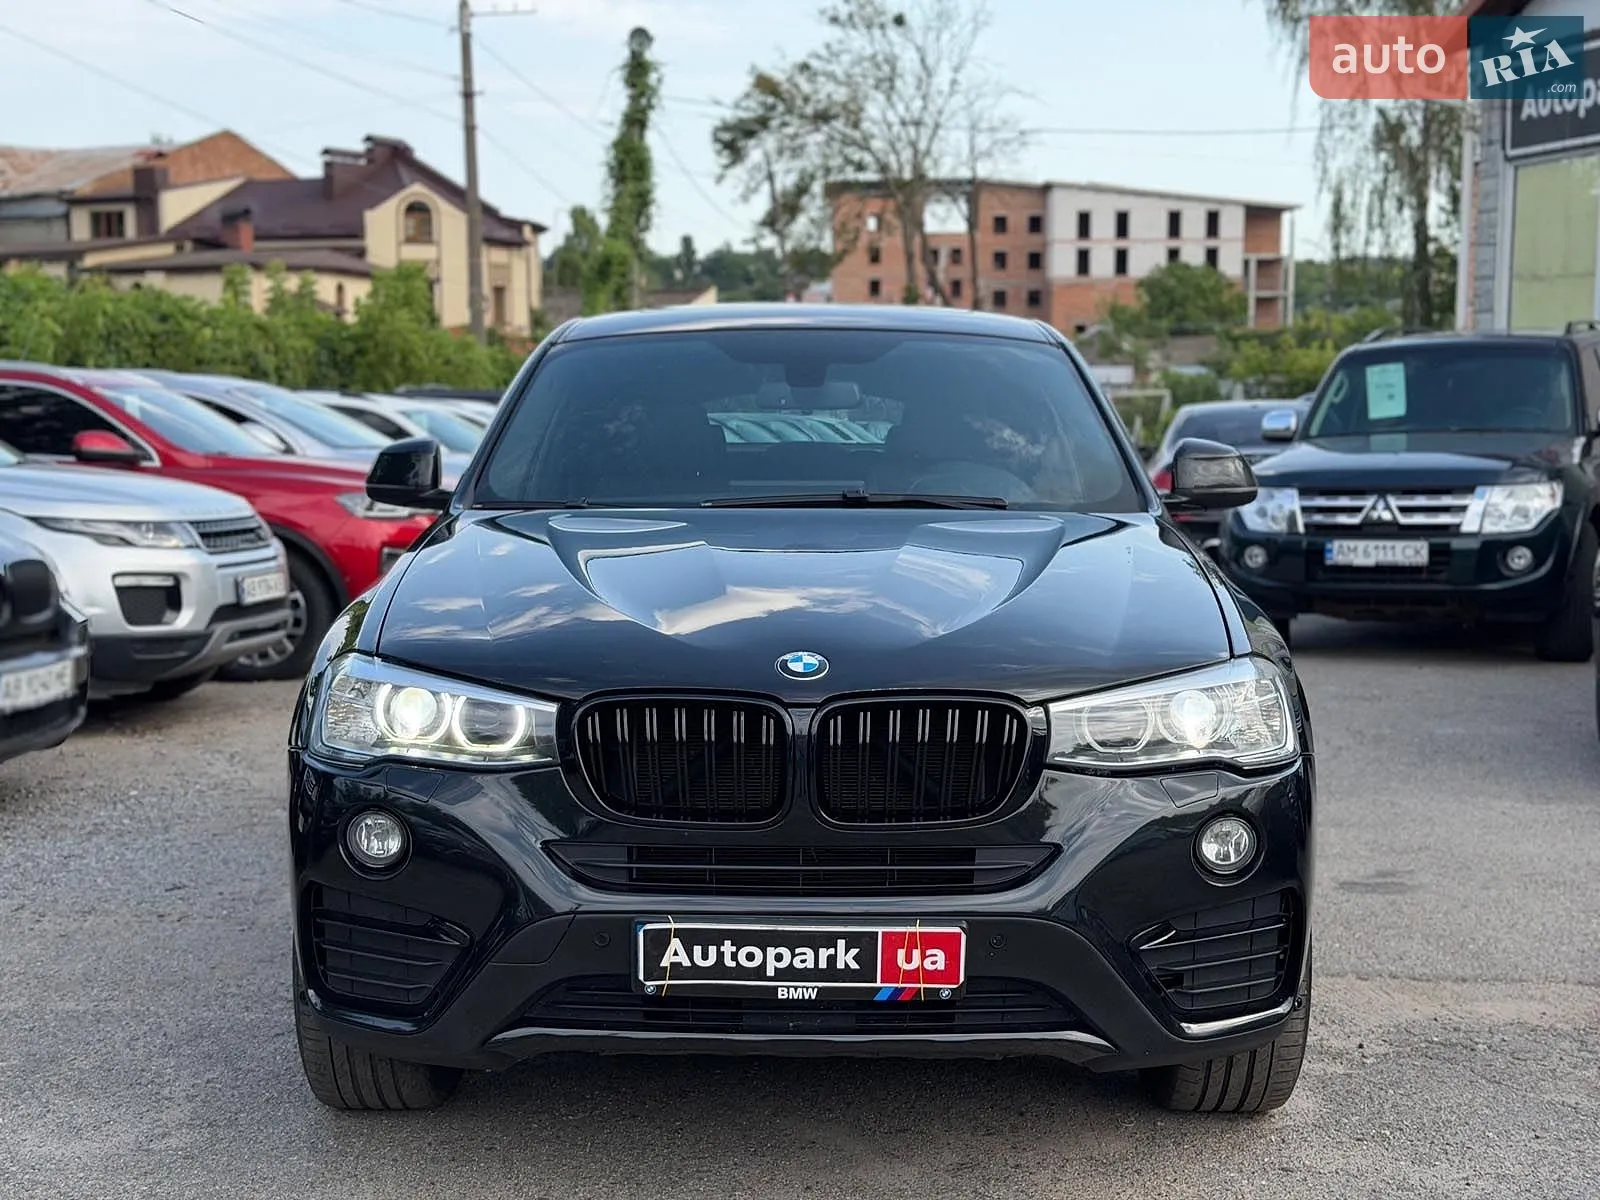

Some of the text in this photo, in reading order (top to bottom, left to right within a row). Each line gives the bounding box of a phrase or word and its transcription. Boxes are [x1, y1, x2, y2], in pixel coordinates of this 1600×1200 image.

[1520, 77, 1600, 121] Autop
[659, 936, 946, 977] Autopark ua
[777, 986, 818, 1000] BMW
